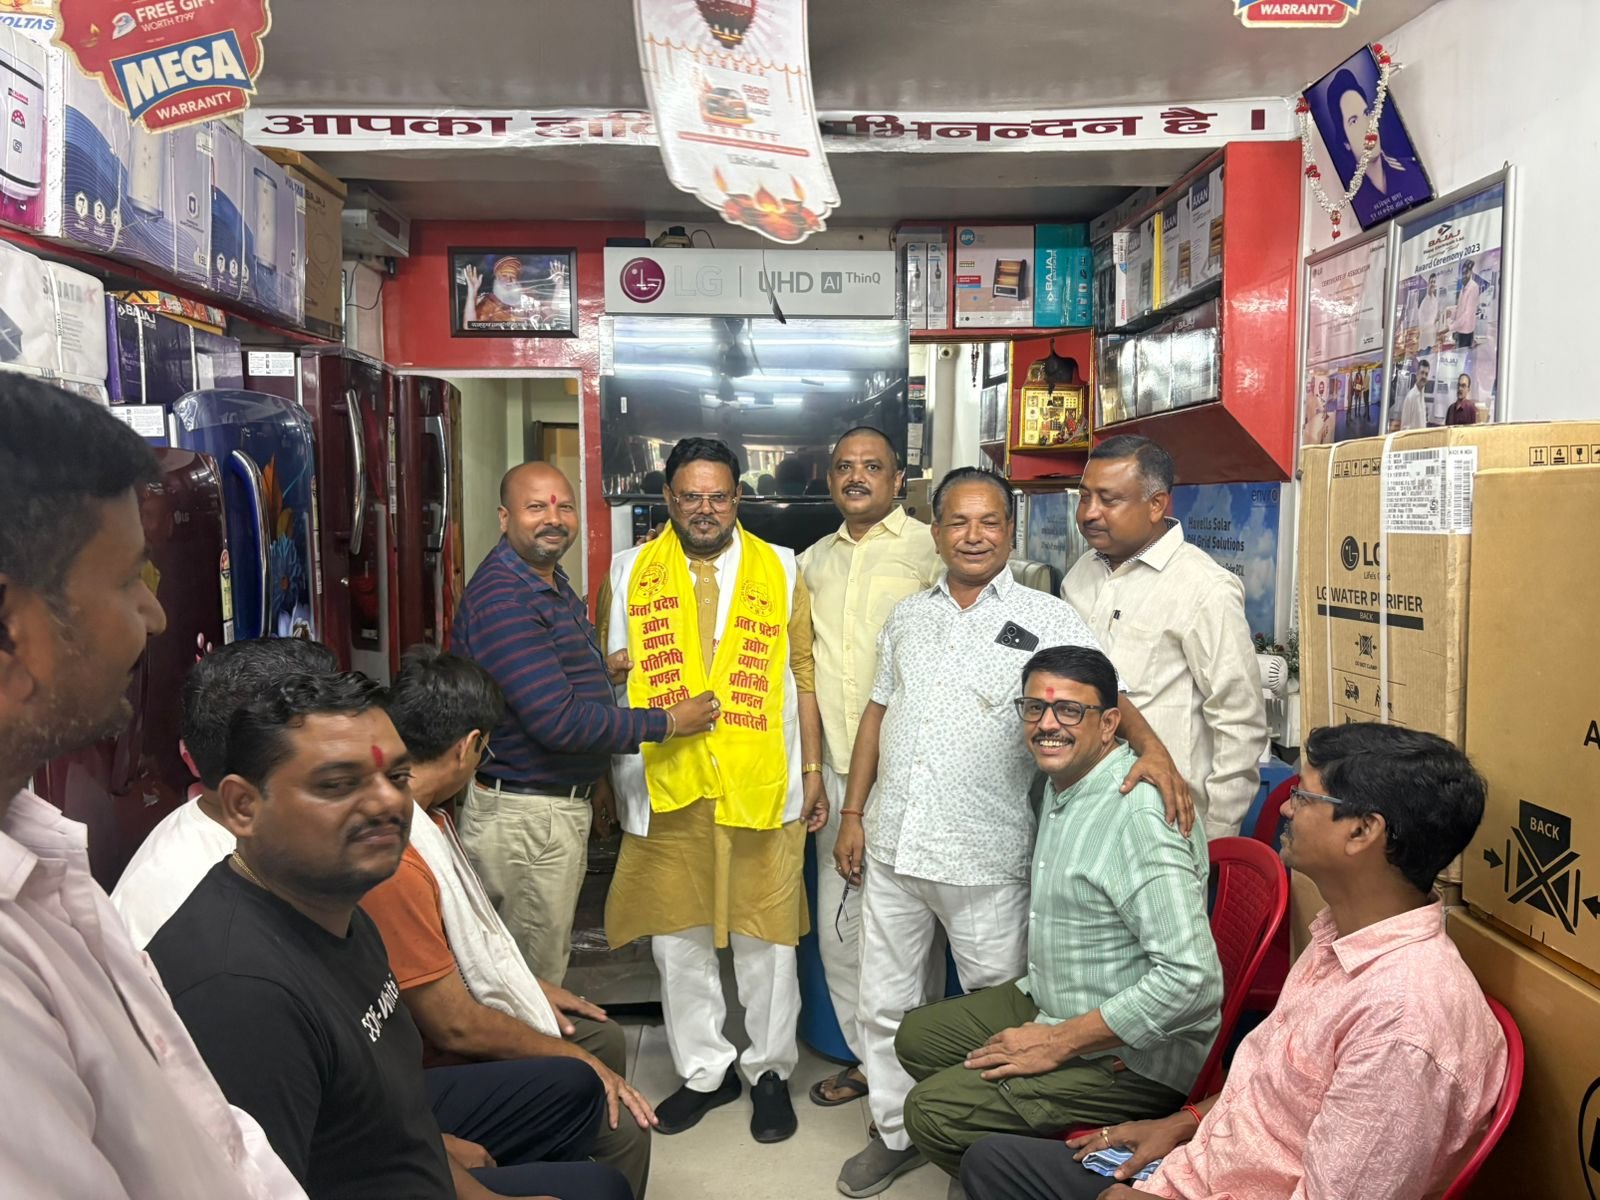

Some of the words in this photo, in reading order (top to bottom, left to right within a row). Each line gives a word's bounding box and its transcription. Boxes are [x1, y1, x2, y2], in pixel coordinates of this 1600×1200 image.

[135, 1, 178, 22] FREE
[1260, 3, 1335, 15] WARRANTY
[141, 18, 175, 32] WORTH
[122, 39, 246, 109] MEGA
[156, 91, 232, 120] WARRANTY
[260, 113, 513, 137] आपका
[1160, 107, 1217, 134] है
[1415, 261, 1433, 274] Award
[1434, 251, 1463, 269] Ceremony
[1463, 243, 1481, 257] 2023
[674, 265, 723, 297] LG
[758, 271, 813, 293] UHD
[822, 273, 841, 291] AI
[845, 272, 881, 284] ThinQ
[1188, 517, 1212, 530] Havells
[1213, 517, 1232, 531] Solar
[1197, 535, 1211, 549] Grid
[1212, 536, 1245, 552] Solutions
[653, 595, 679, 612] प्रदेश
[1331, 586, 1368, 606] WATER
[642, 616, 669, 635] उद्योग
[1359, 611, 1374, 620] BACK
[734, 616, 757, 633] उत्तर
[759, 621, 780, 638] प्रदेश
[642, 632, 675, 650] व्यापार
[742, 637, 769, 655] उद्योग
[640, 648, 684, 673] प्रतिनिधि
[738, 653, 769, 672] व्यापार
[648, 668, 681, 687] मण्डल
[728, 670, 769, 693] प्रतिनिधि
[731, 690, 764, 710] मण्डल
[1529, 816, 1560, 841] BACK
